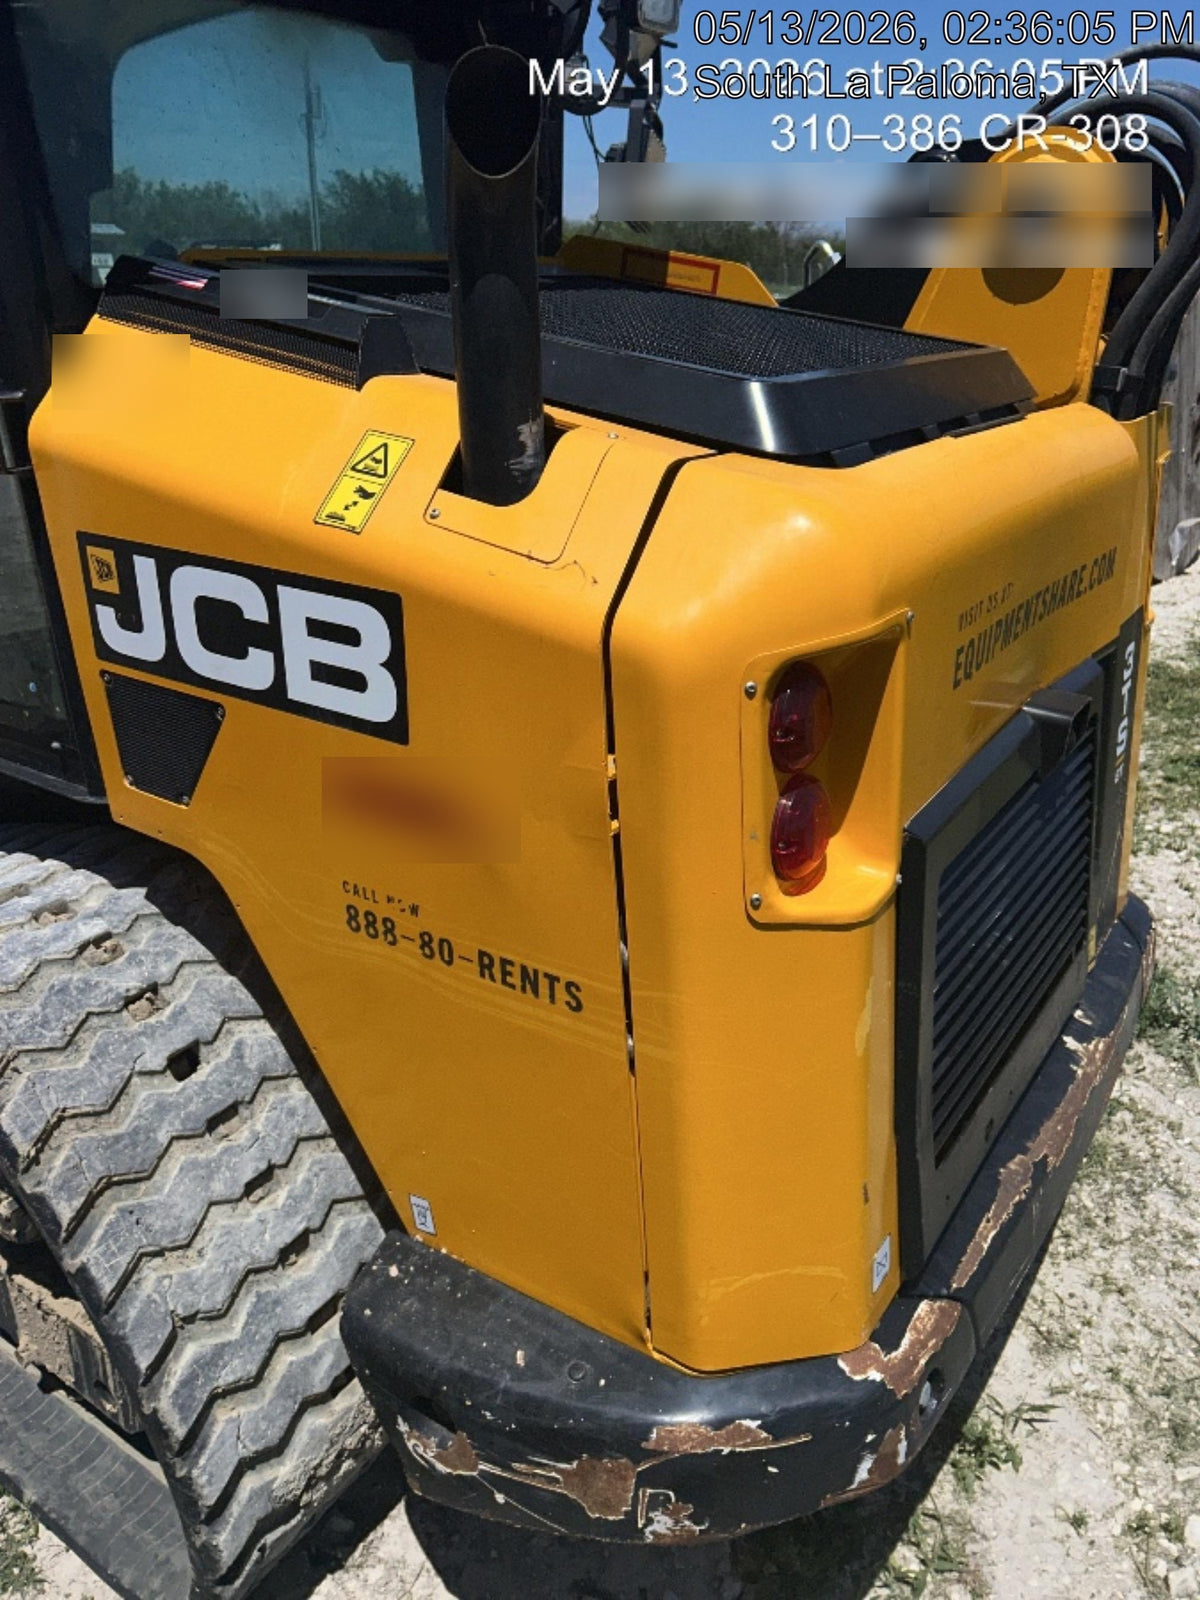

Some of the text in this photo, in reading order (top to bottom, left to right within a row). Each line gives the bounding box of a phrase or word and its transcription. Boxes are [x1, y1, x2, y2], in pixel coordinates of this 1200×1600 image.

[95, 554, 397, 723] JCB
[953, 546, 1118, 691] EQUIPMENTSHARE.COM
[342, 880, 380, 904] CALL
[346, 904, 584, 1013] 888-80-RENTS
